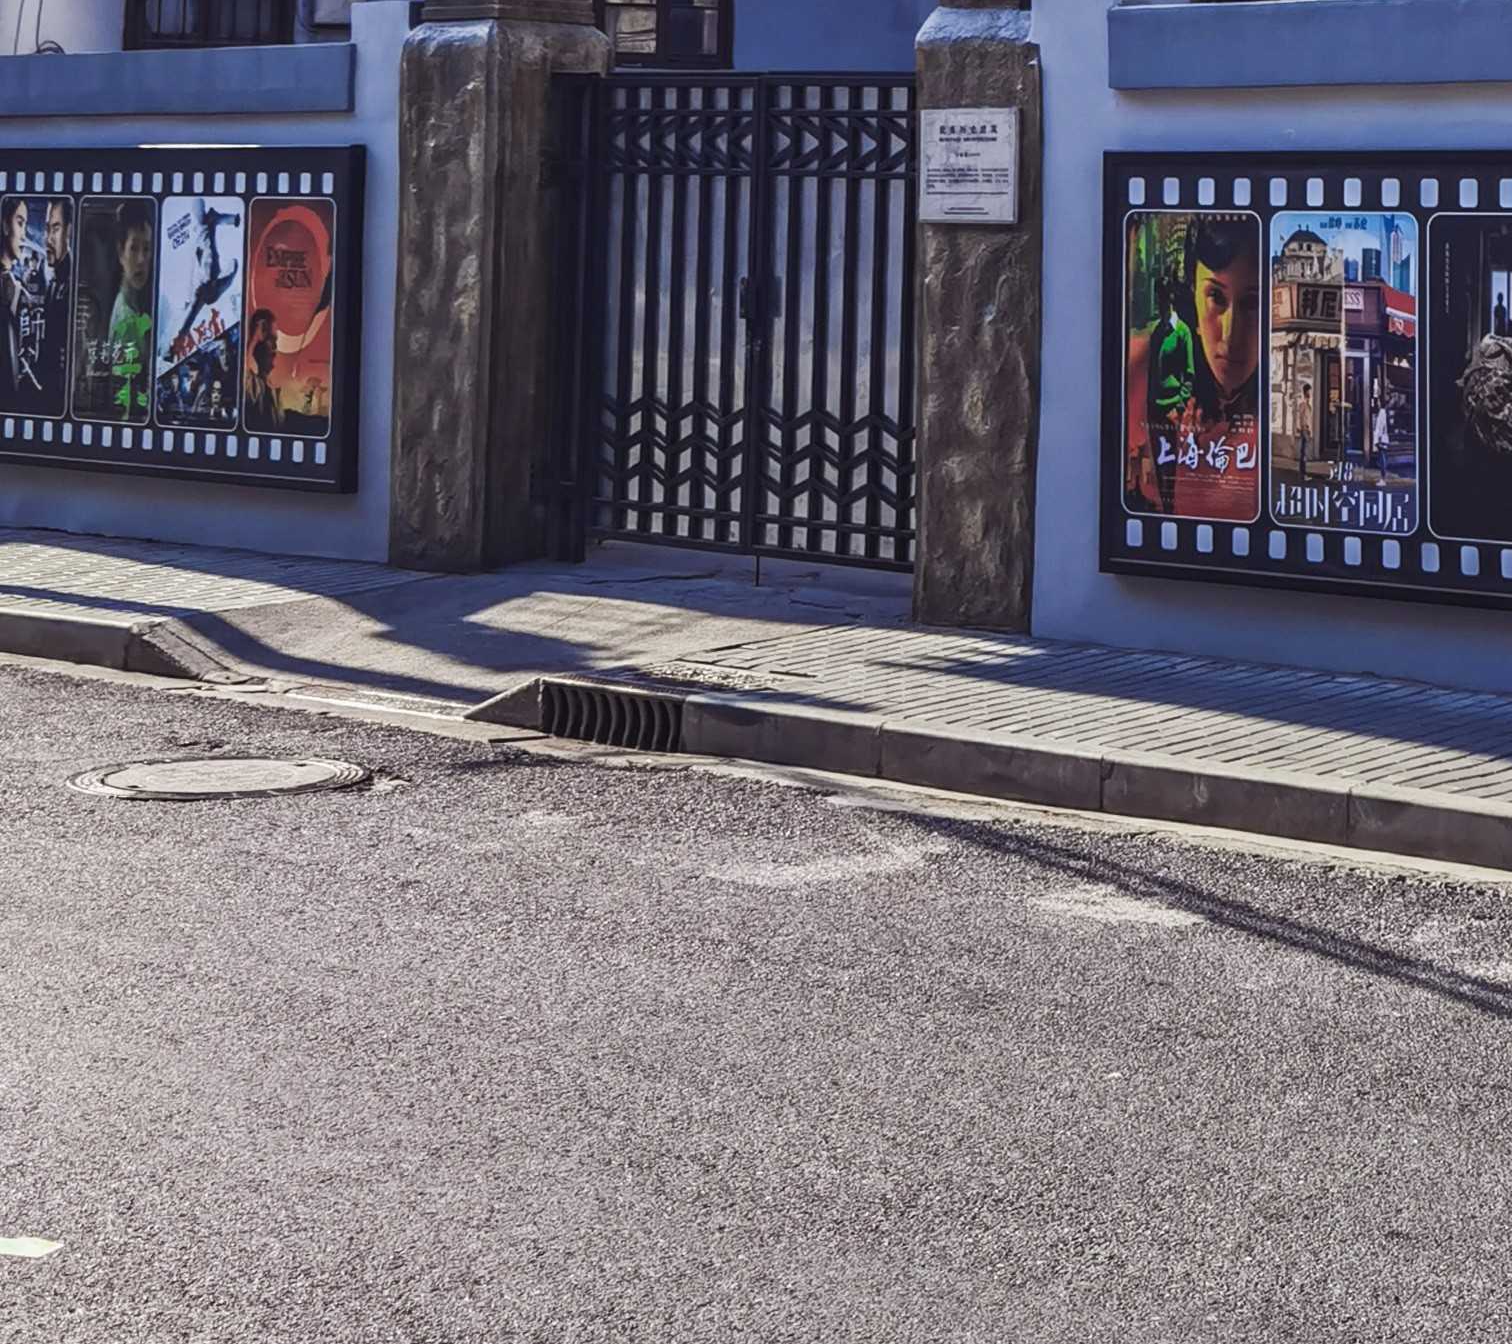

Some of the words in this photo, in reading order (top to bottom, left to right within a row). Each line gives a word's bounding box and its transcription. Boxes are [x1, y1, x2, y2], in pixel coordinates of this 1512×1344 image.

[265, 246, 307, 268] EMPIRE
[1275, 483, 1409, 531] 超时空同居
